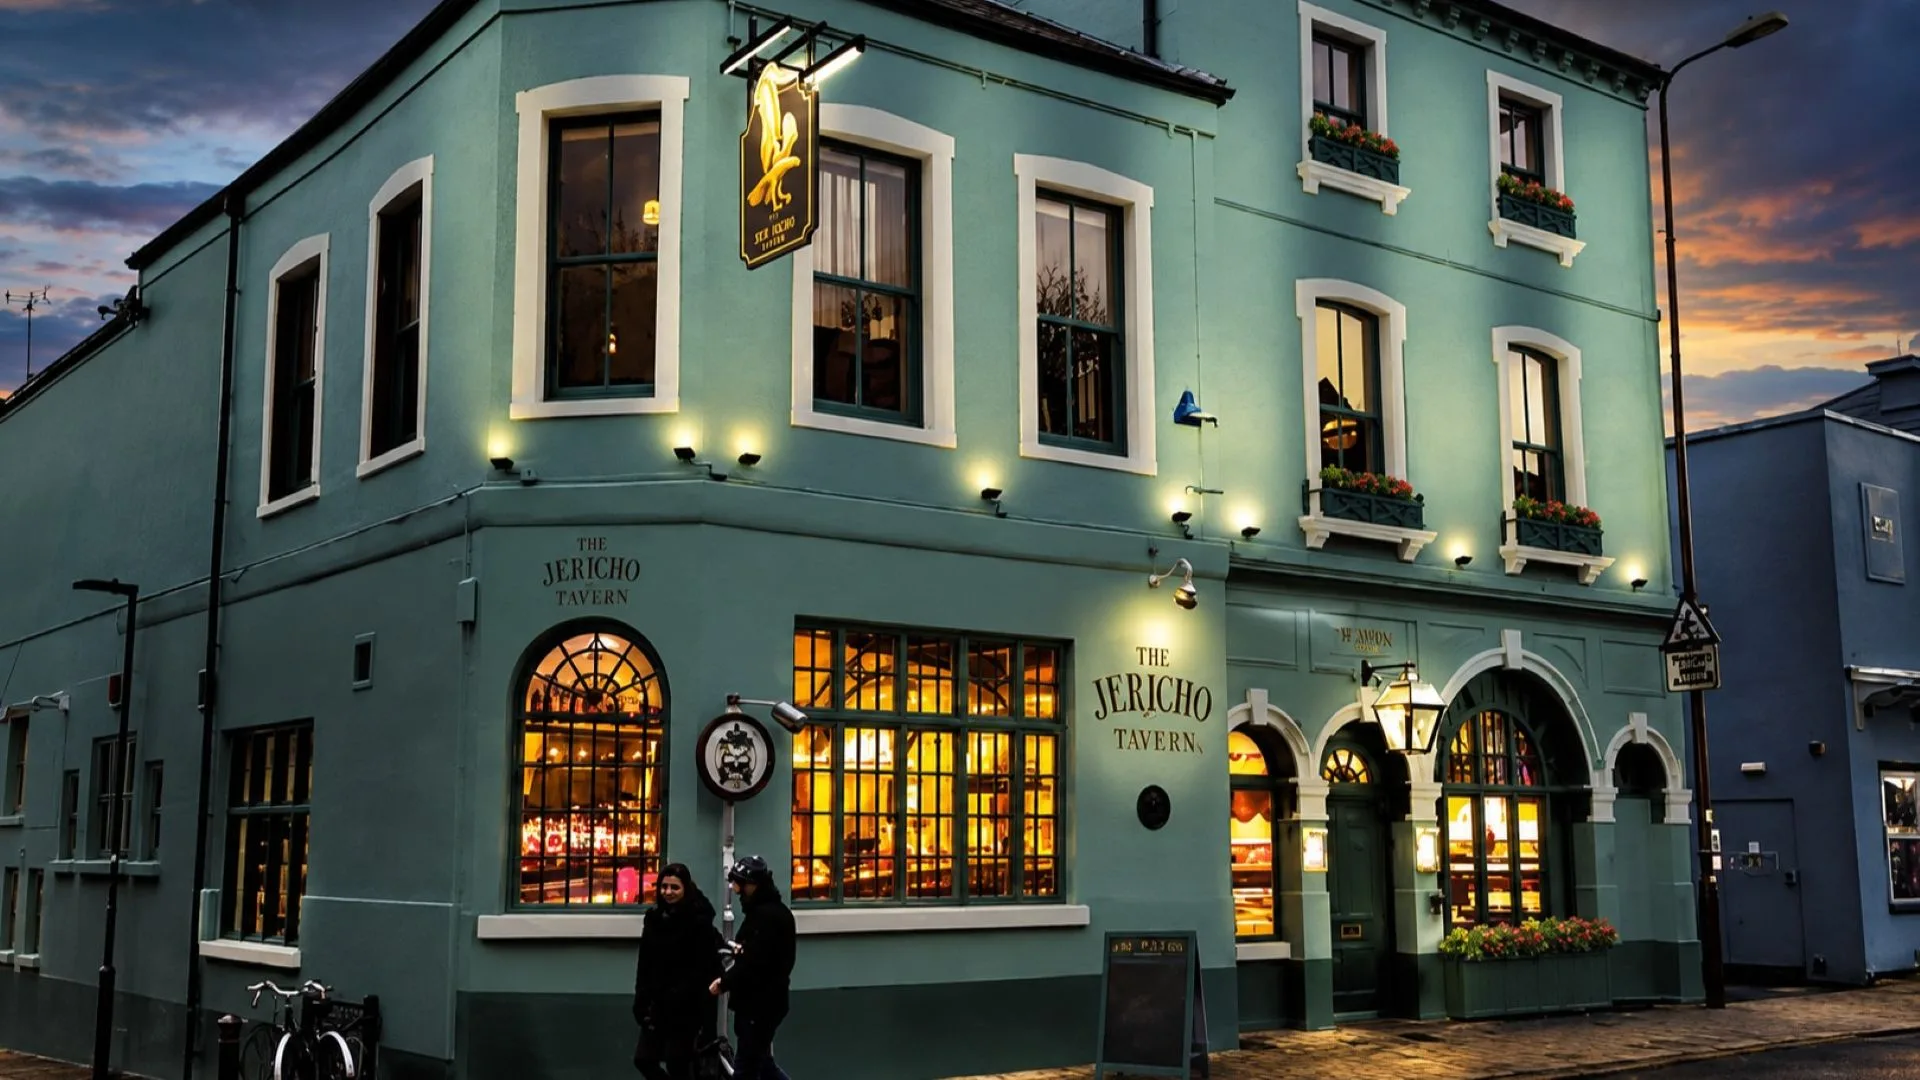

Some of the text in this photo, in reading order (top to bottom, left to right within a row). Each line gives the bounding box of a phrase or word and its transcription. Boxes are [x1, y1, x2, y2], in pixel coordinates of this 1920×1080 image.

[576, 536, 608, 552] THE
[543, 556, 640, 587] JERICHO
[555, 589, 630, 606] TAVERN
[1135, 646, 1170, 668] THE
[1092, 672, 1213, 723] JERICHO
[1113, 728, 1196, 753] TAVERN
